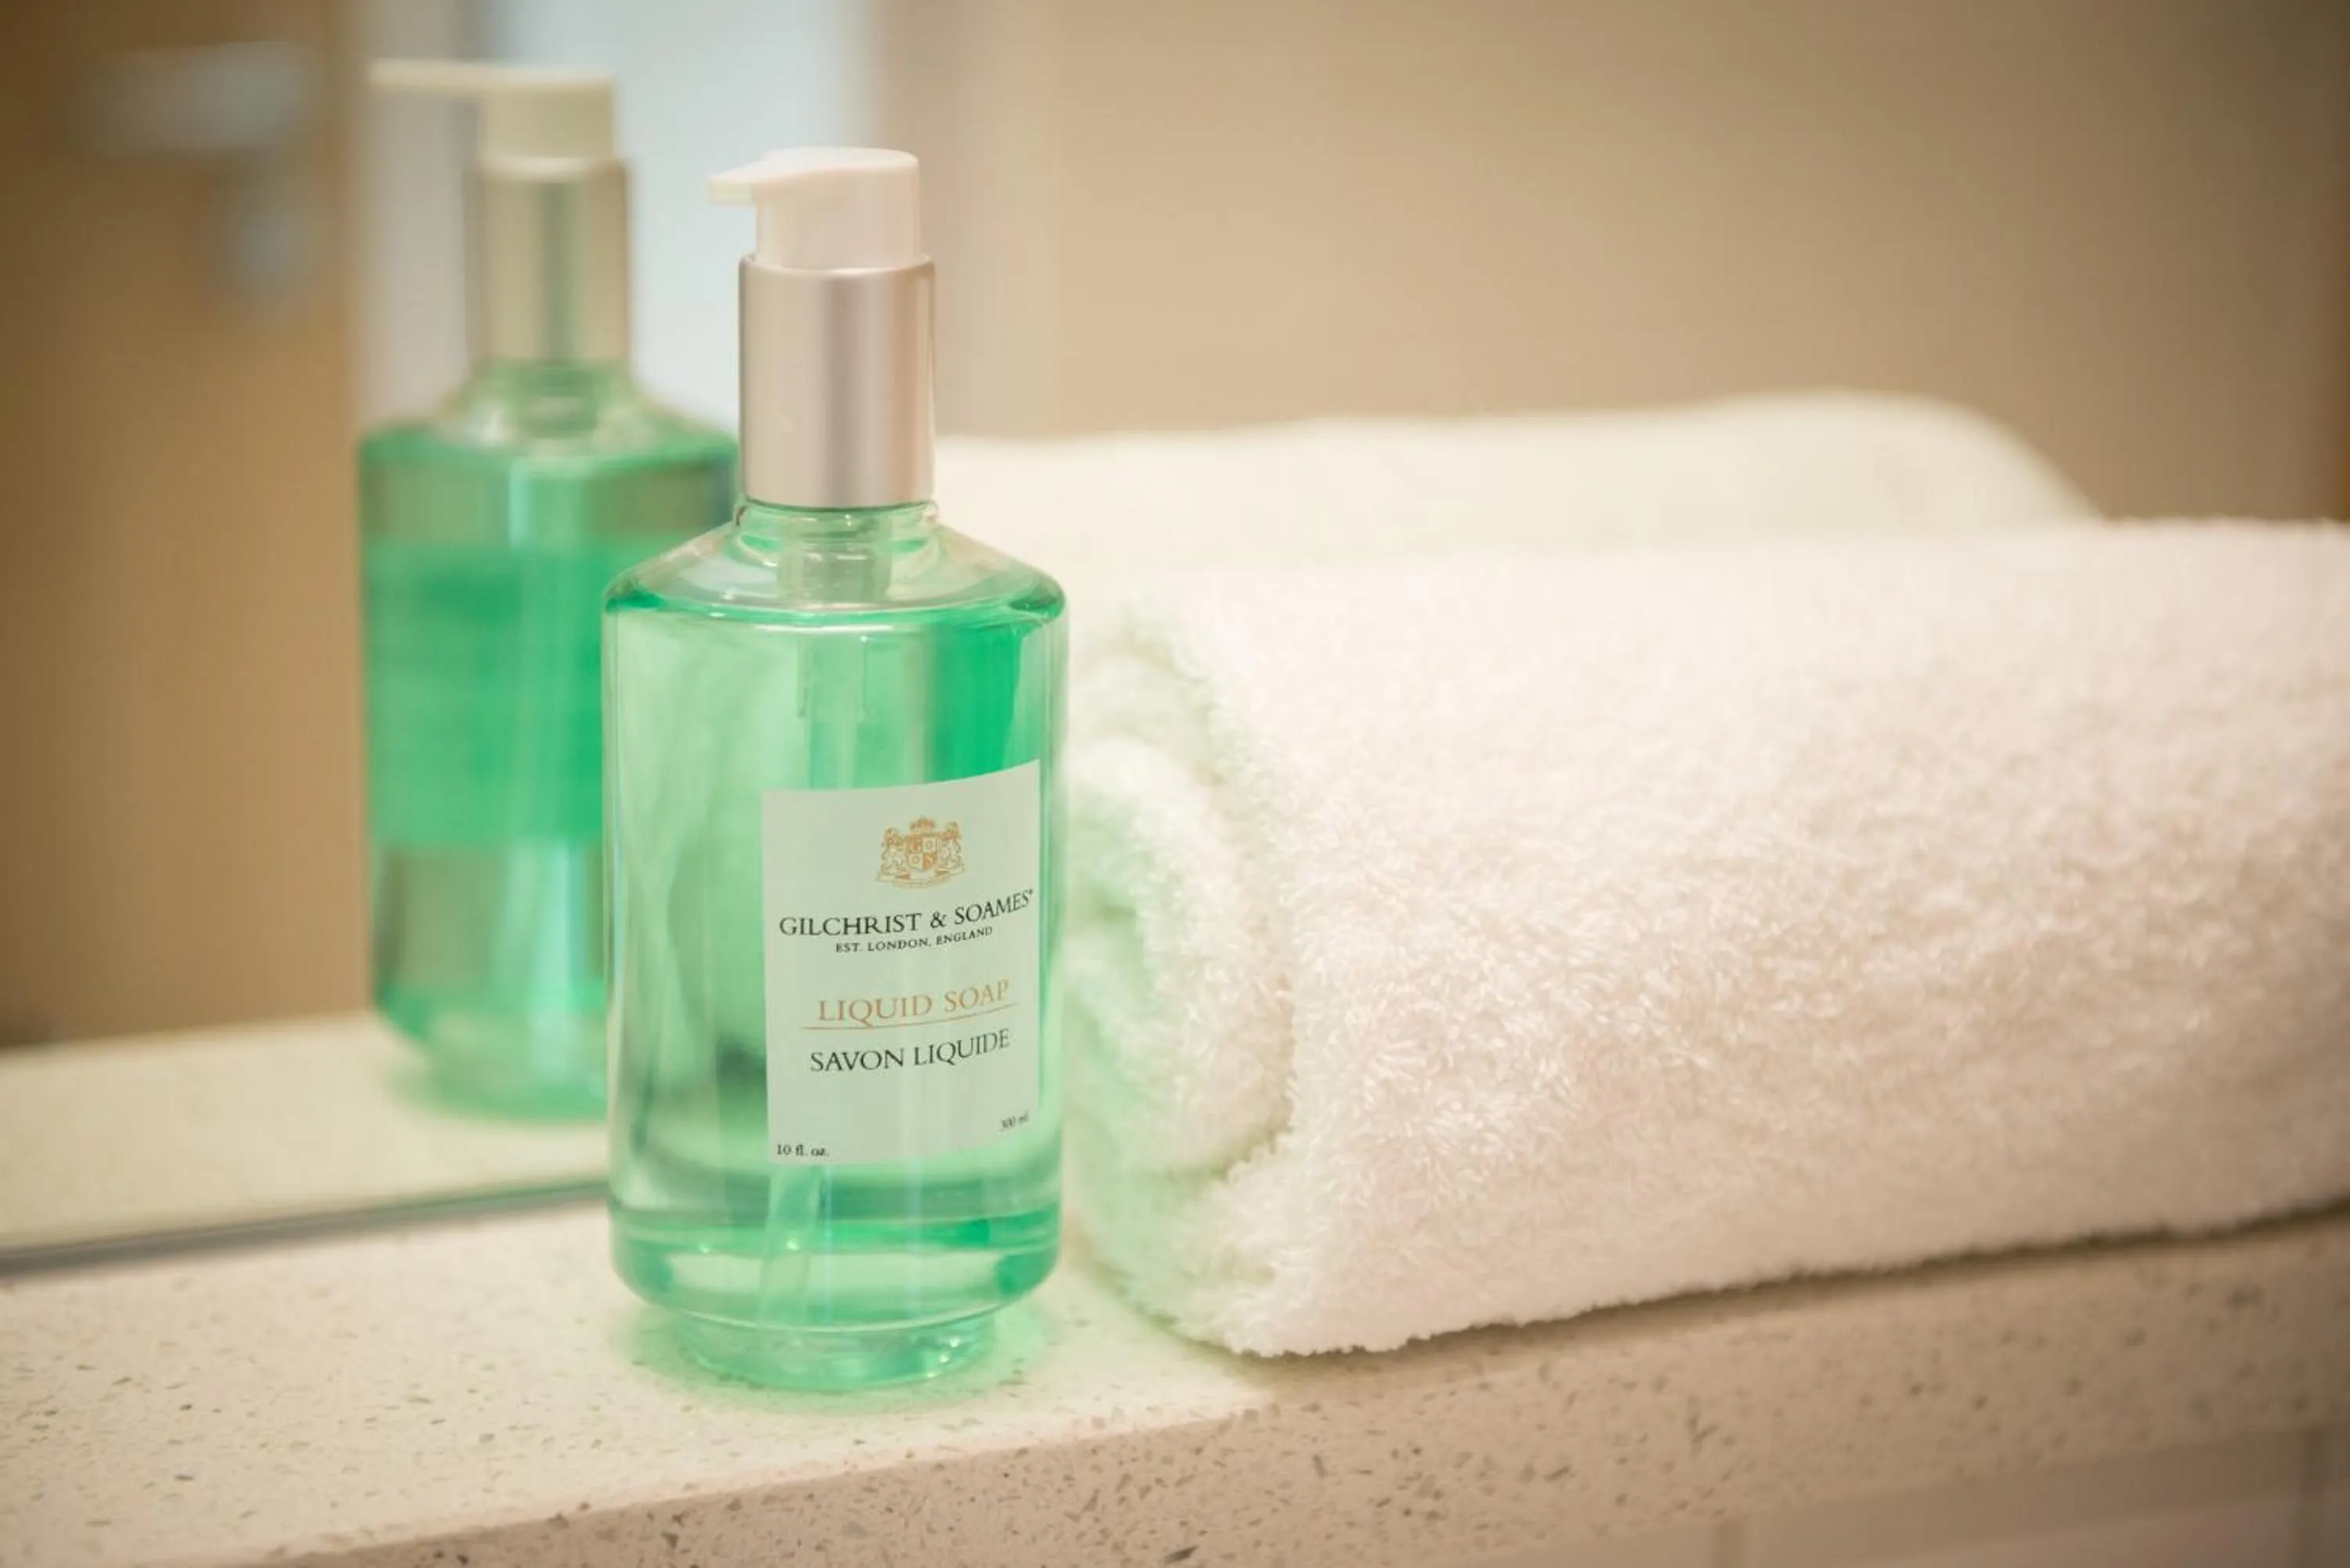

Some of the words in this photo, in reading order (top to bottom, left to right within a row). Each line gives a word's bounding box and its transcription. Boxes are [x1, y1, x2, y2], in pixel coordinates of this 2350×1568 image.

[779, 912, 922, 936] GILCHRIST
[930, 911, 947, 929] &
[936, 926, 992, 945] ENGLAND
[818, 995, 933, 1028] LIQUID
[943, 979, 1009, 1013] SOAP
[810, 1048, 904, 1072] SAVON
[913, 1028, 1010, 1066] LIQUIDE
[776, 1144, 792, 1156] 10
